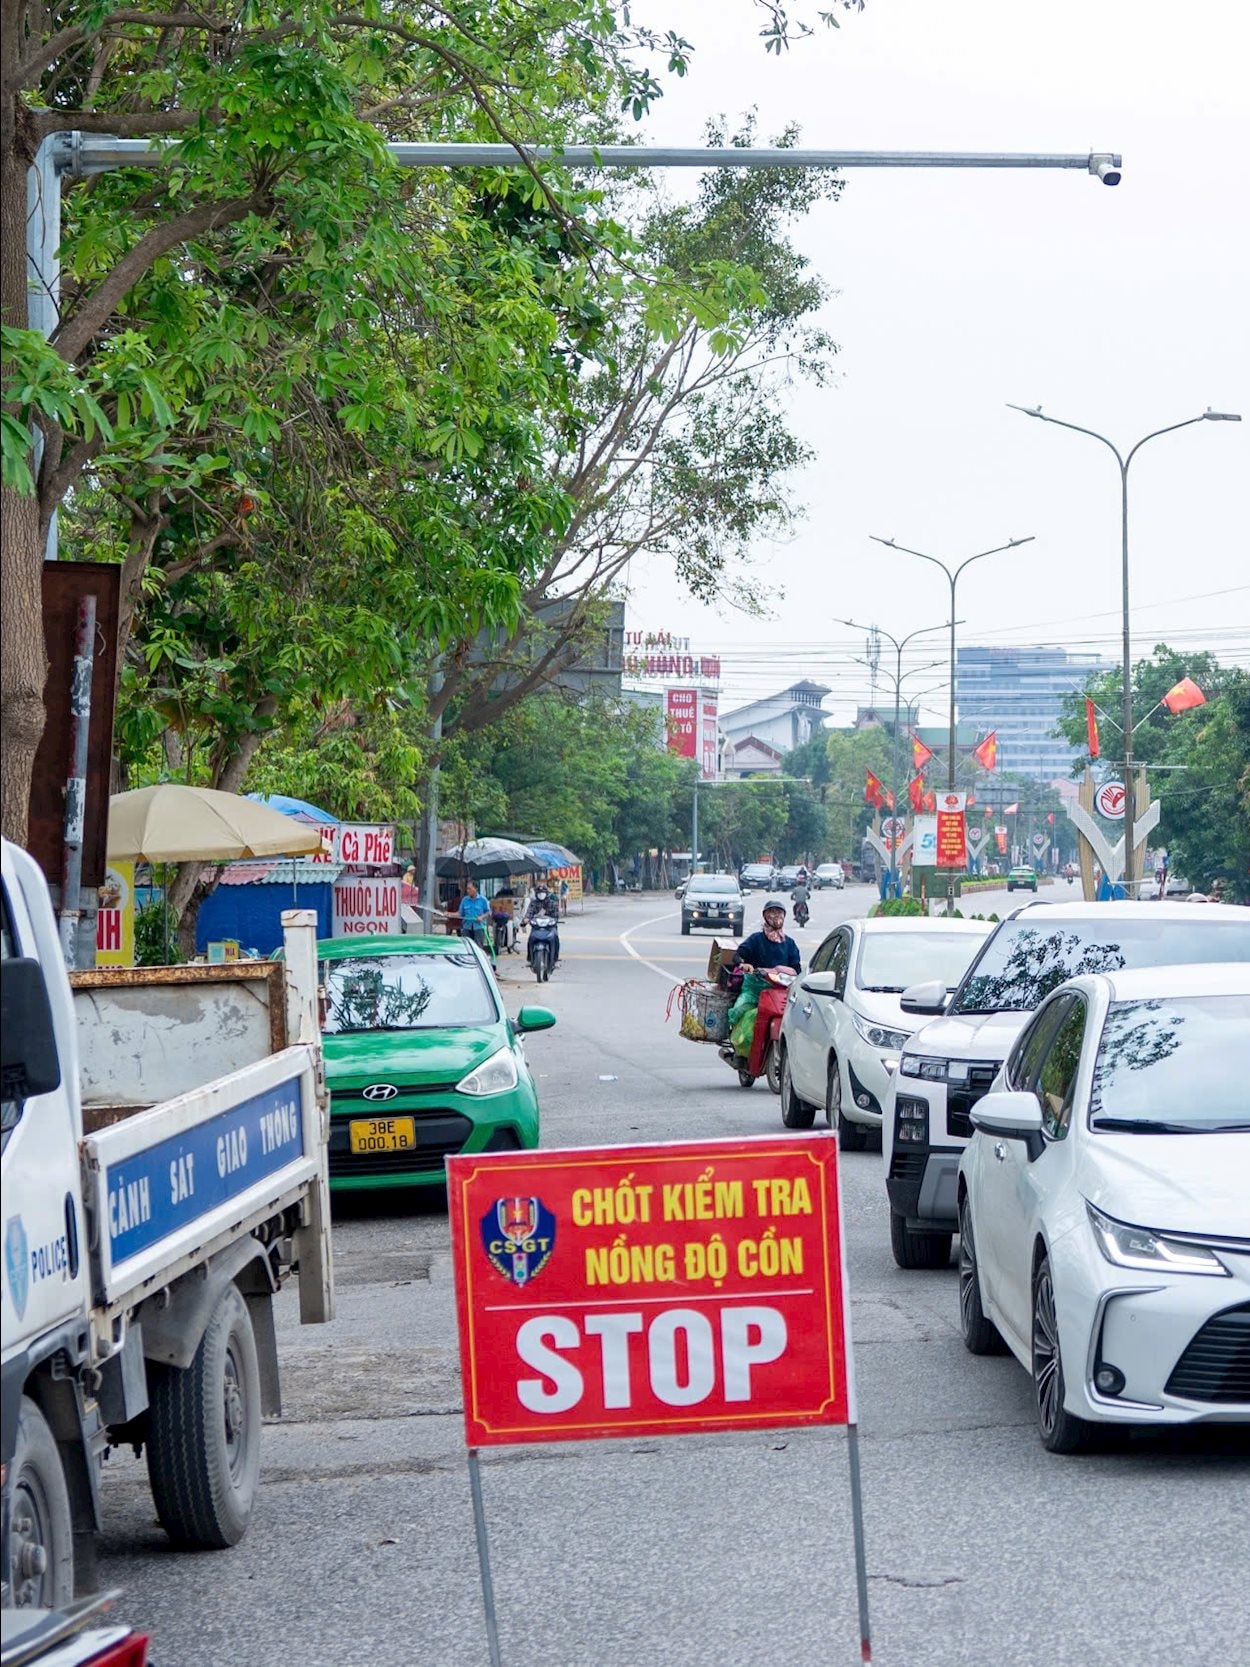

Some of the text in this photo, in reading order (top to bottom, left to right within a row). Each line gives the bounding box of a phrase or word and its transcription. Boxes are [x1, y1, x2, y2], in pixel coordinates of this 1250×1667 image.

[670, 707, 694, 719] THUÊ
[672, 693, 692, 703] CHO
[681, 722, 692, 734] TÔ
[342, 831, 390, 863] Cà Phê
[375, 880, 397, 917] LÀO
[344, 921, 388, 933] NGON
[358, 1135, 408, 1150] 000.18
[369, 1121, 395, 1135] 38E
[108, 1101, 297, 1239] CẢNH SÁT GIAO THÔNG
[572, 1167, 813, 1227] CHỐT KIỂM TRA
[32, 1236, 67, 1283] POLICE
[585, 1225, 803, 1287] NỒNG ĐỘ CỒN
[515, 1305, 788, 1414] STOP
